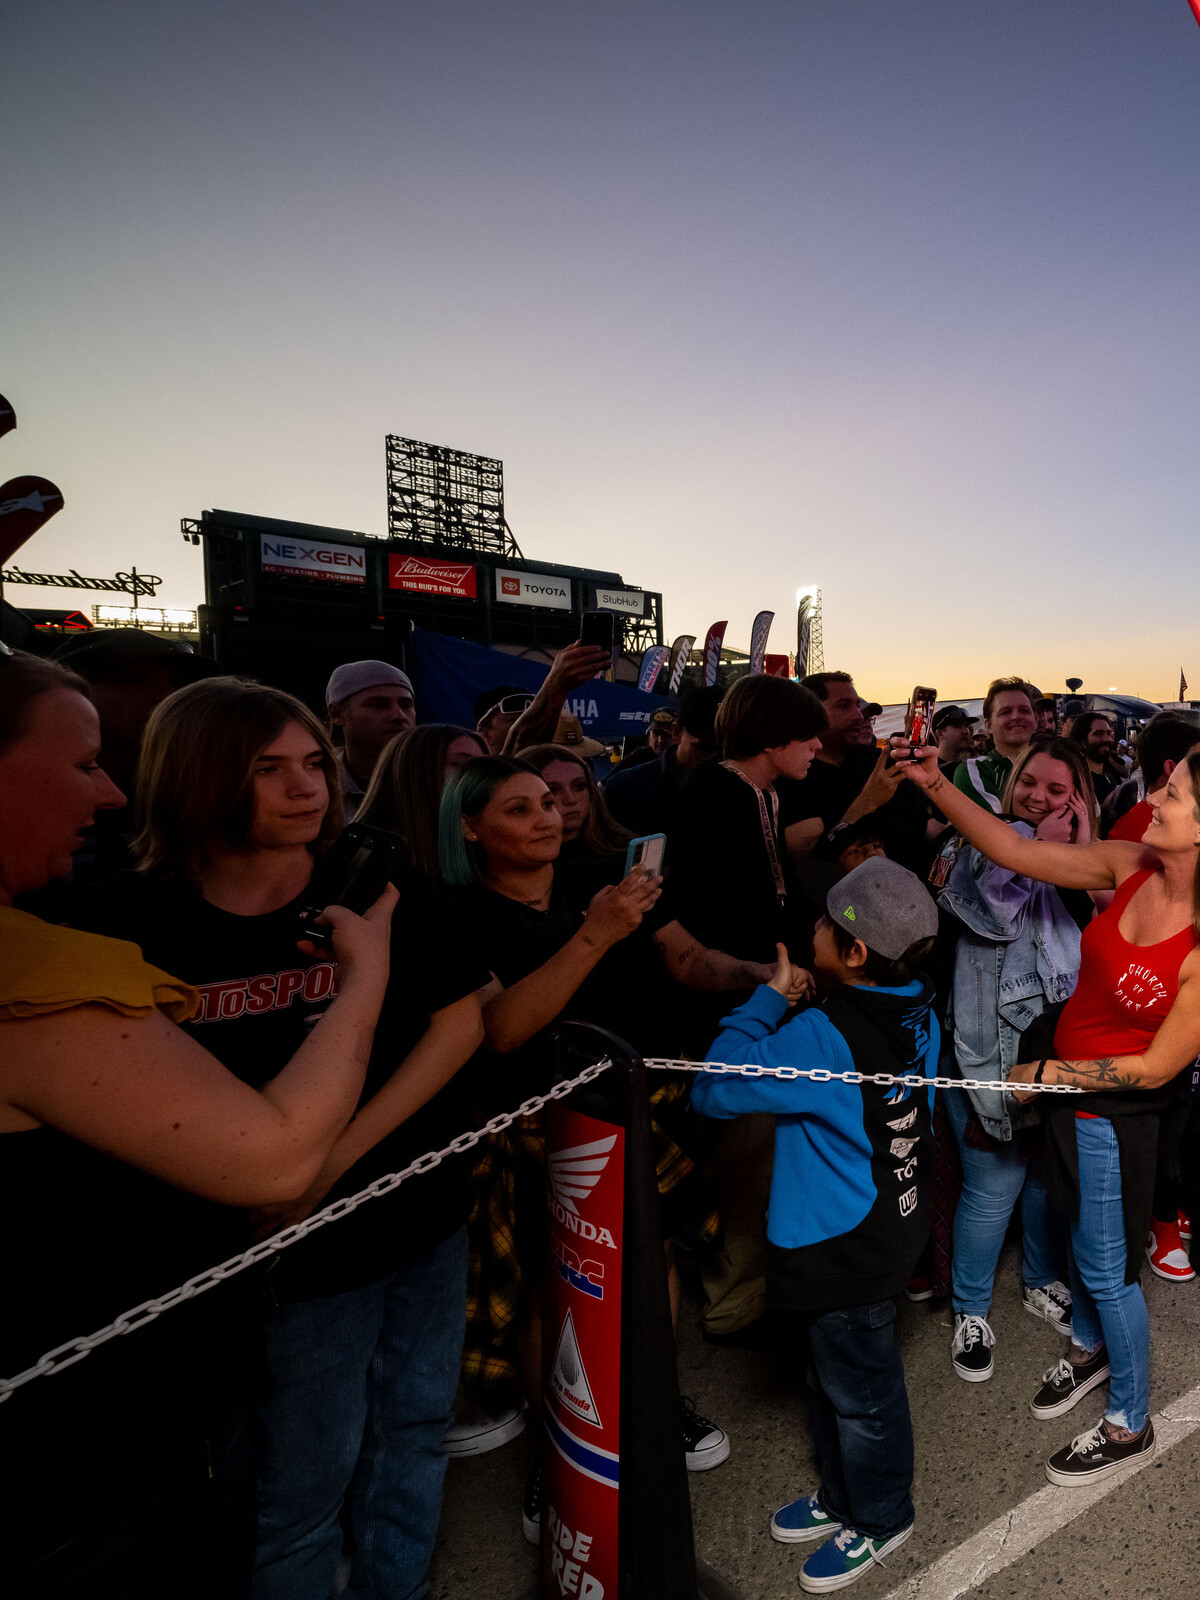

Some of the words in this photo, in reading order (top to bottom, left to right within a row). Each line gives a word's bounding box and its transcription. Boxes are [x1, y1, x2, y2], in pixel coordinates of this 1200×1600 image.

[263, 542, 363, 568] NEXGEN
[284, 568, 319, 577] HEATING
[326, 572, 364, 582] PLUMBING
[401, 562, 464, 579] Budweiser
[402, 580, 417, 589] THIS
[418, 583, 438, 591] BUD'S
[439, 585, 452, 593] FOR
[524, 584, 567, 597] TOYOTA
[602, 594, 639, 608] StubHub
[668, 637, 693, 694] THOR
[562, 698, 600, 718] AHA
[1128, 963, 1168, 998] CHURCH
[1132, 983, 1145, 995] OF
[190, 962, 340, 1025] TOSPO
[1114, 989, 1142, 1012] DIRT
[546, 1191, 618, 1250] HONDA
[563, 1388, 591, 1412] Honda
[548, 1504, 593, 1563] RIDE
[551, 1540, 605, 1600] RED
